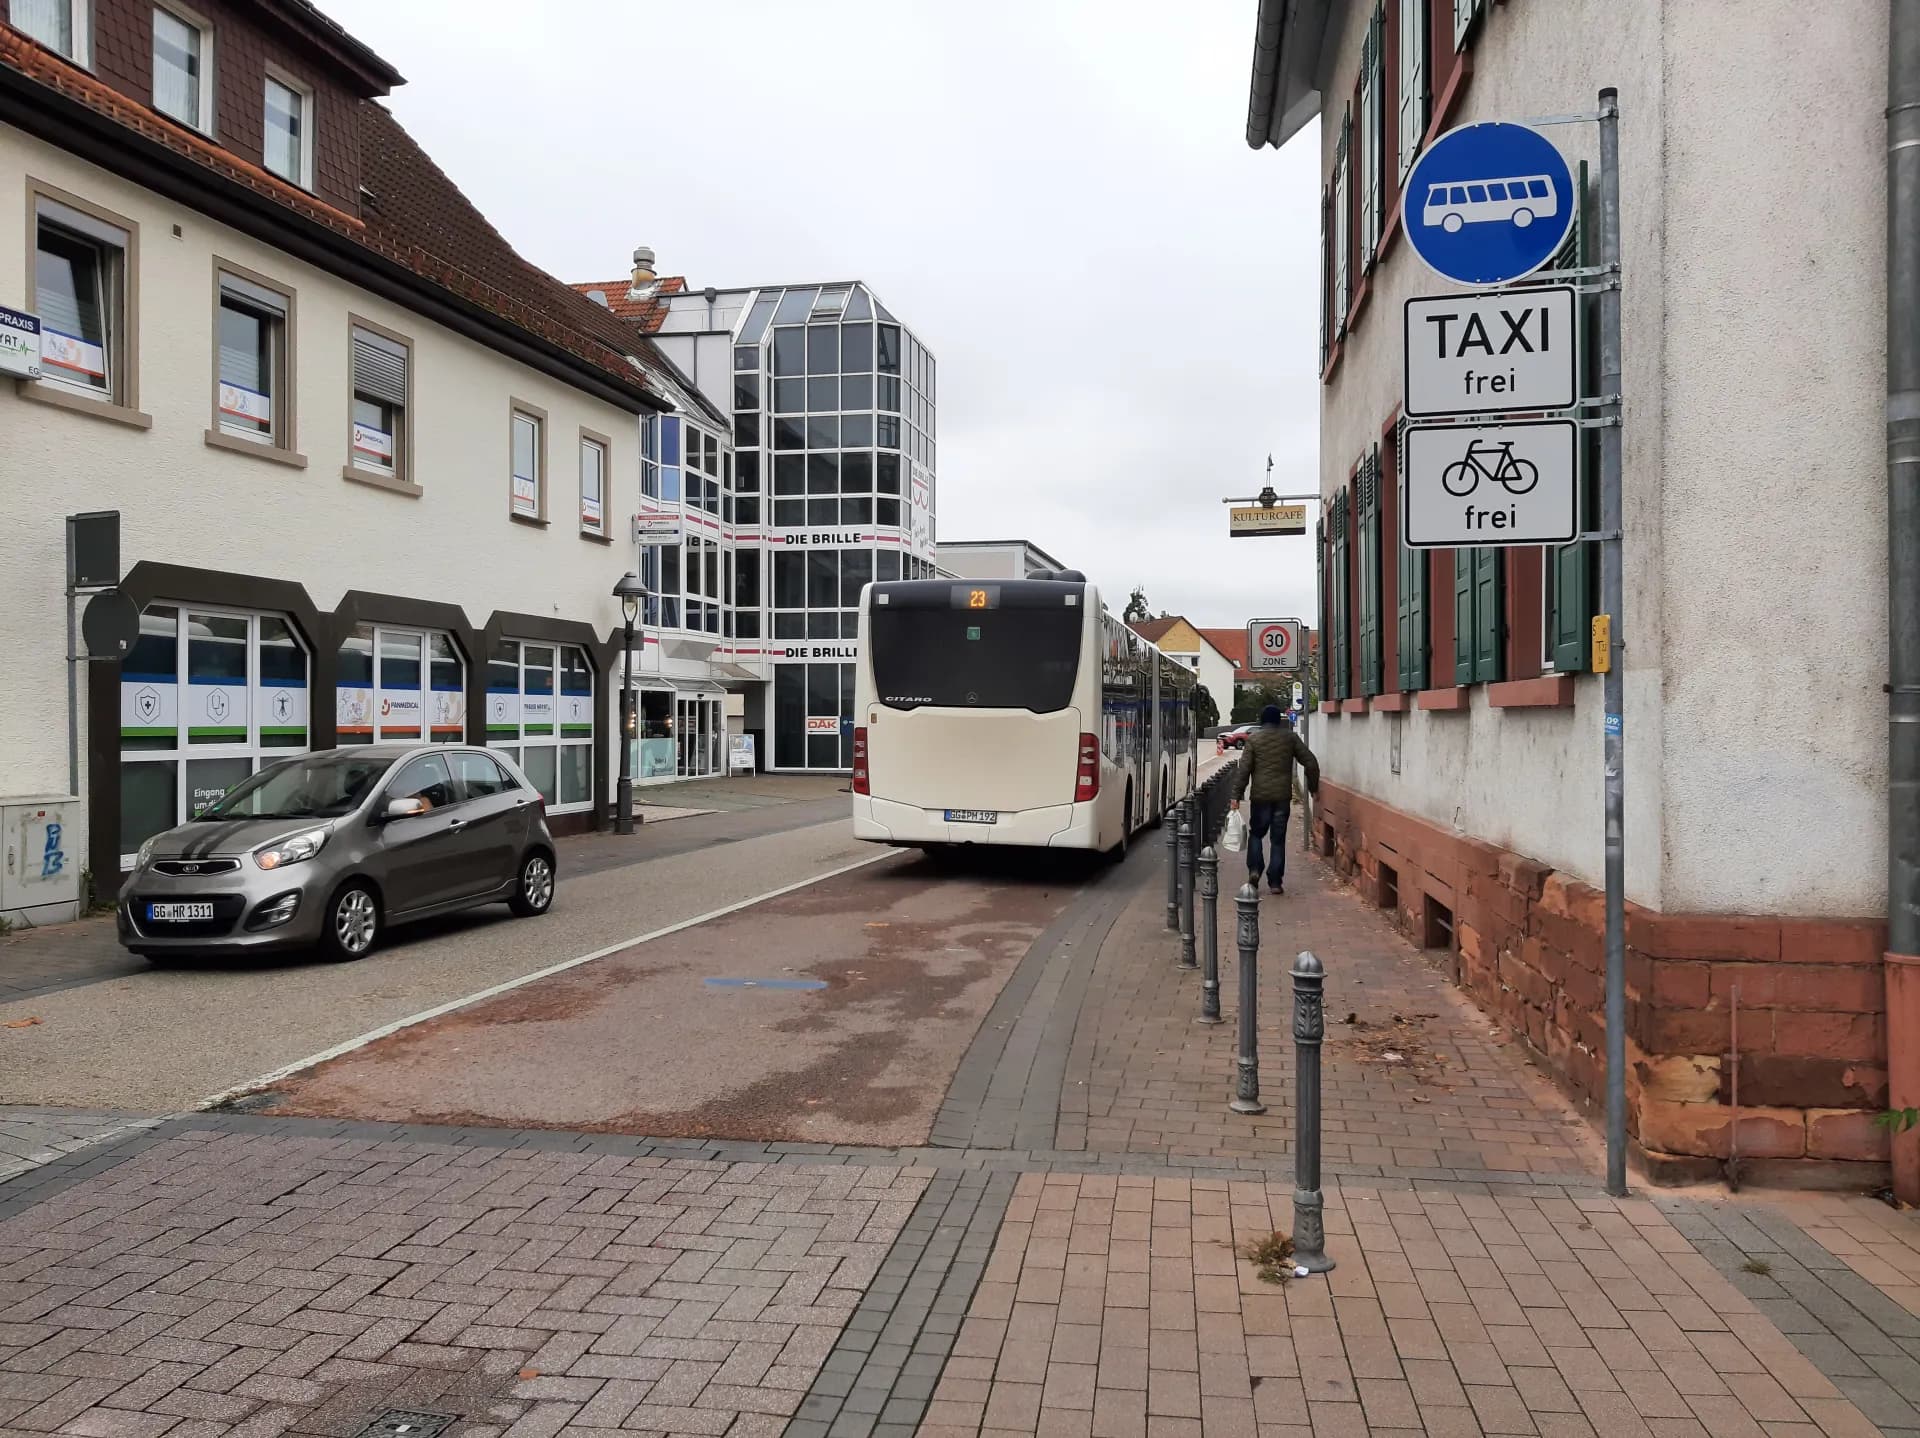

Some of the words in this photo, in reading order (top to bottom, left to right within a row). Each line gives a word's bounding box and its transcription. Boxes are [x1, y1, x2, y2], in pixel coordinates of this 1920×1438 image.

[1426, 308, 1549, 358] TAXI
[1464, 368, 1515, 394] frei
[1465, 504, 1516, 529] frei
[785, 534, 808, 545] DIE
[812, 532, 861, 544] BRILLE
[970, 590, 986, 607] 23
[1265, 633, 1284, 648] 30
[785, 647, 808, 658] DIE
[1262, 657, 1287, 666] ZONE
[391, 701, 419, 709] PANMEDICAL
[808, 719, 837, 729] DAK
[194, 787, 225, 799] Eingang
[153, 905, 166, 918] GG
[172, 905, 185, 918] HR
[187, 904, 212, 918] 1311
